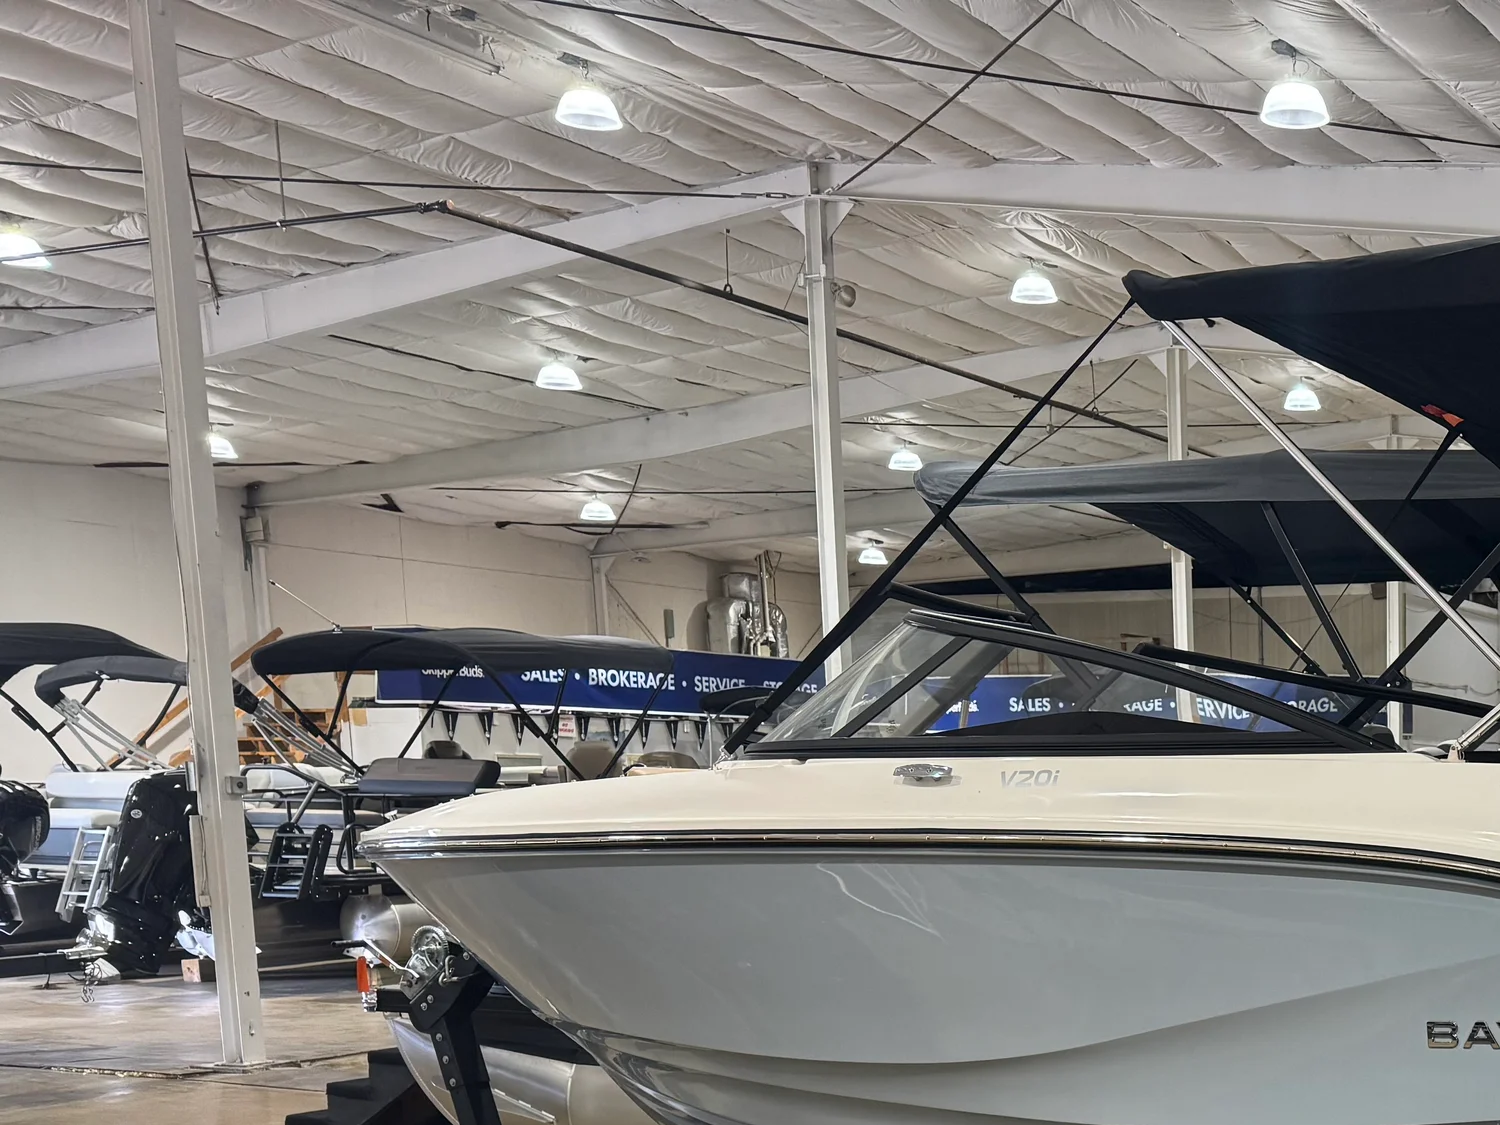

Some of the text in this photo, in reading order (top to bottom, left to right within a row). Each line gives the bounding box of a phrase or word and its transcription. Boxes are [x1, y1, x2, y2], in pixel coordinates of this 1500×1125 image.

[1009, 697, 1051, 713] SALES
[1196, 697, 1250, 720] ERVICE
[1000, 769, 1060, 788] V20i
